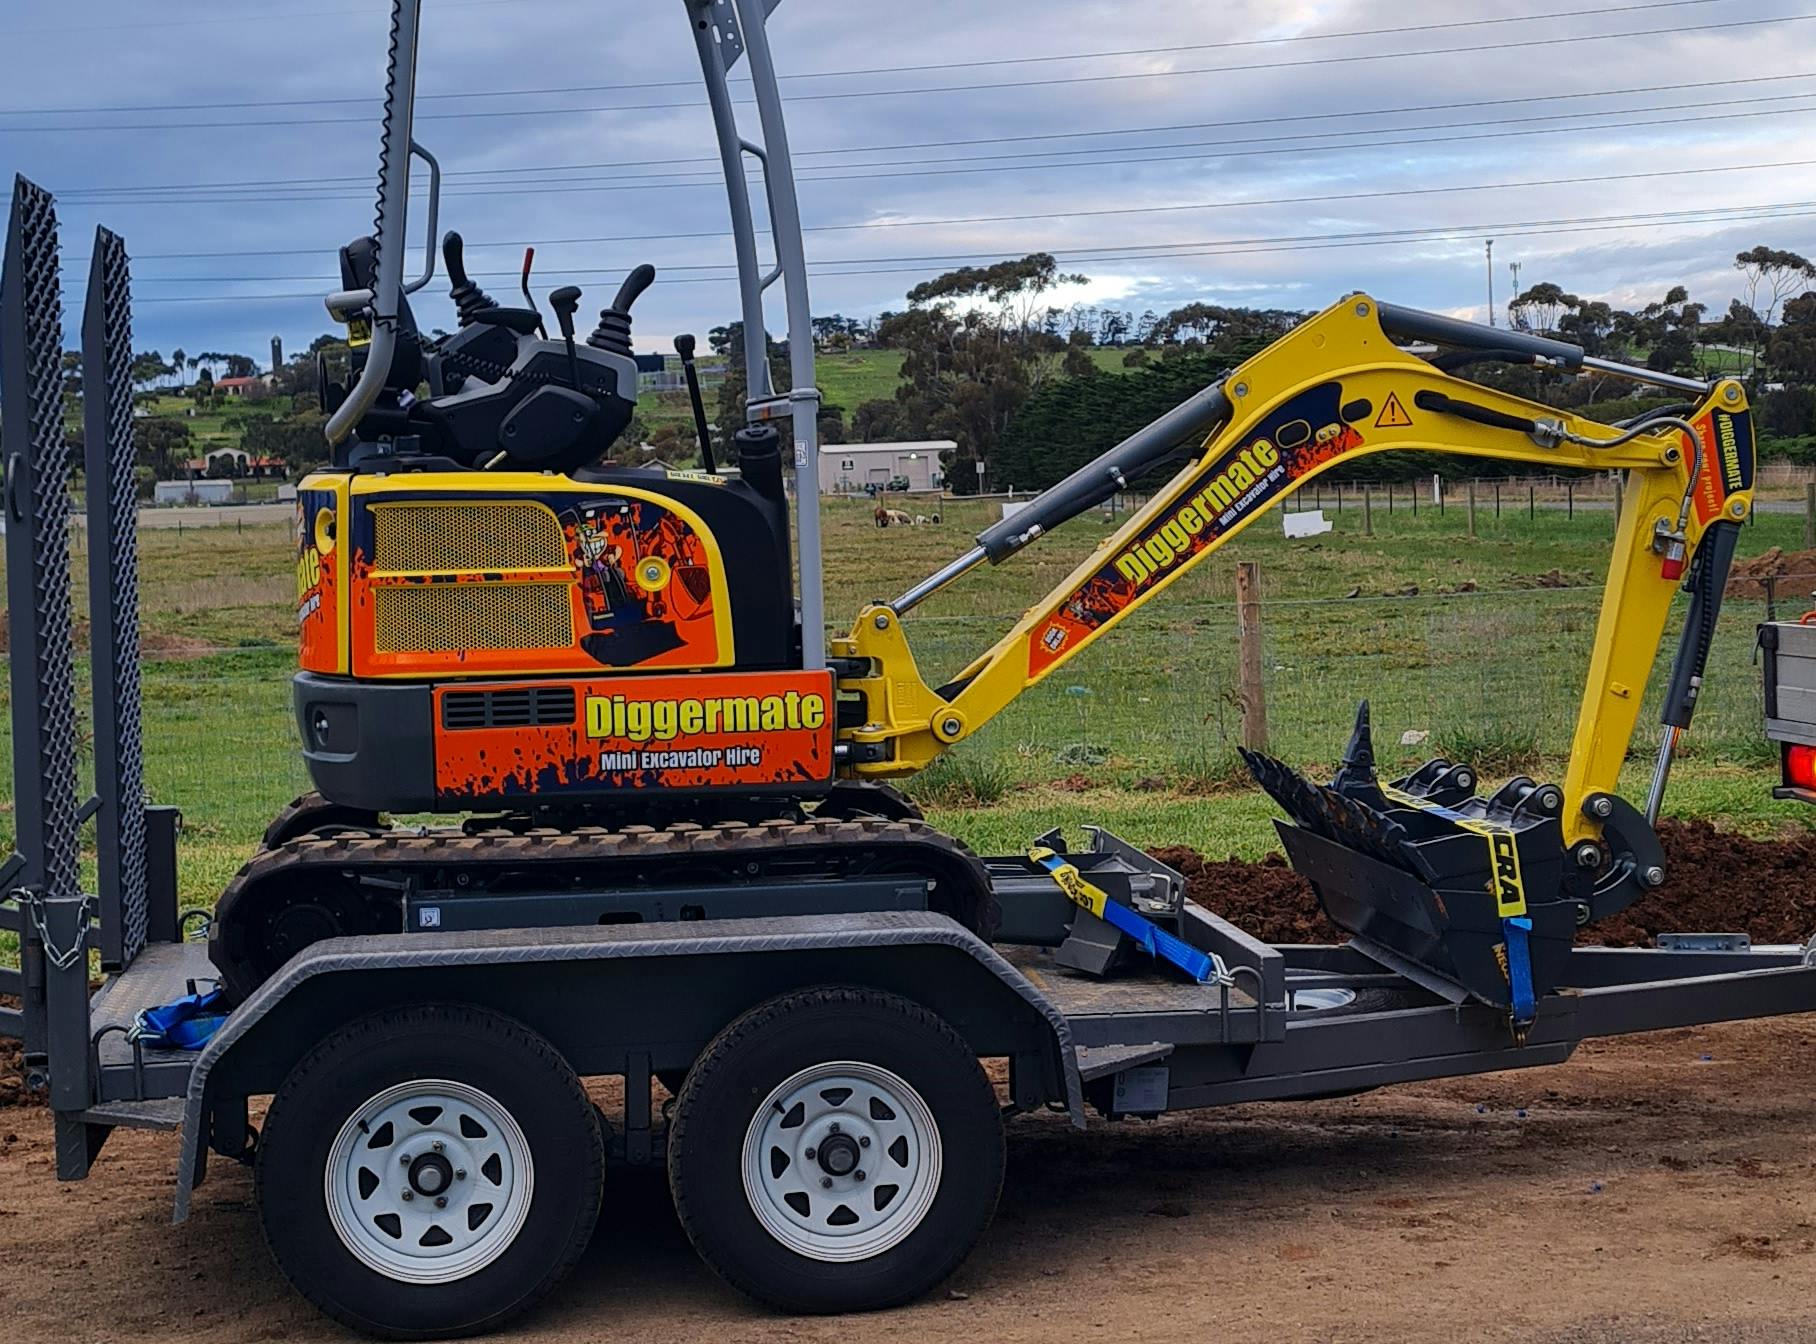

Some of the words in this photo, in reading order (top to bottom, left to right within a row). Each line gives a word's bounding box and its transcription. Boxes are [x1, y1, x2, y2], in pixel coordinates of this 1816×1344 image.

[1718, 414, 1743, 489] #DIGGERMATE
[1115, 439, 1279, 586] Diggermate
[1219, 507, 1238, 526] Mini
[1234, 478, 1269, 512] Excavator
[585, 690, 825, 741] Diggermate
[601, 751, 637, 770] Mini
[641, 748, 722, 769] Excavator
[726, 746, 760, 765] Hire
